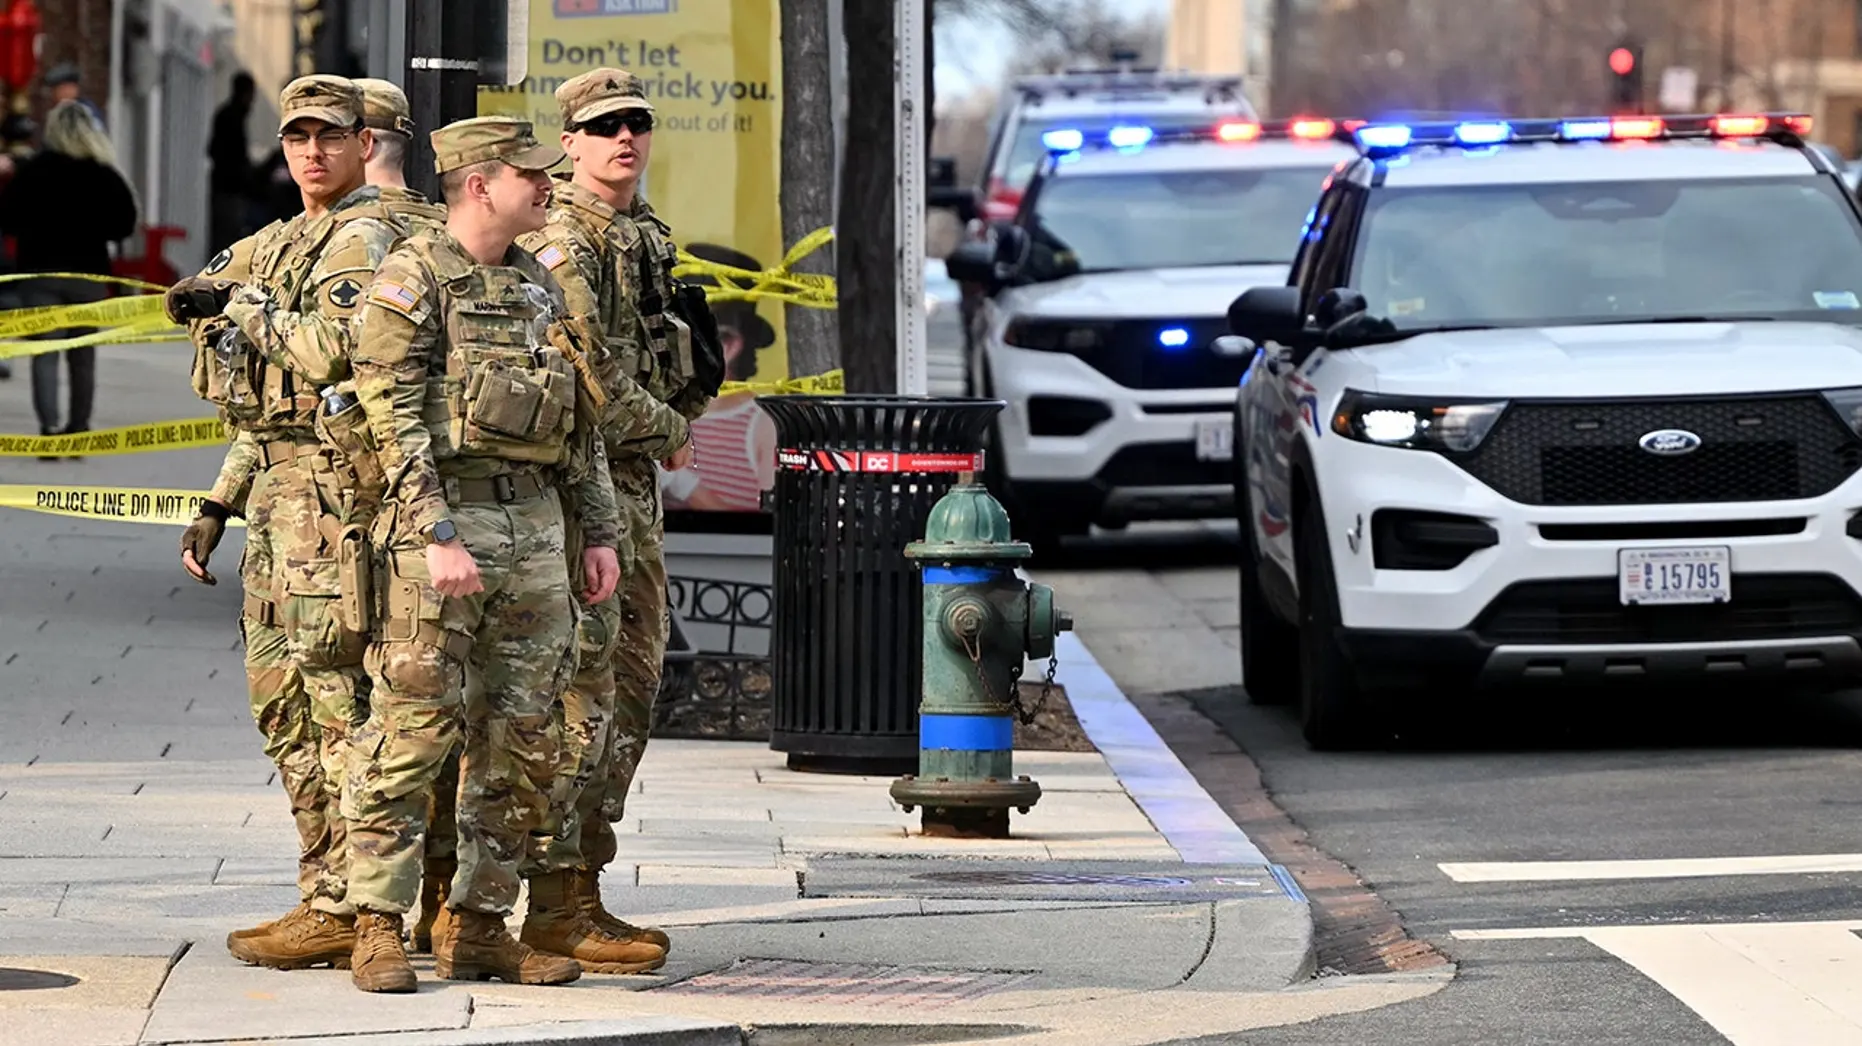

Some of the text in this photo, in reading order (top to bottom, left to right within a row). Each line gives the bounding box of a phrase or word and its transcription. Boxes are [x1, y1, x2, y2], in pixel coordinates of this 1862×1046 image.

[543, 39, 681, 67] Don't let
[643, 72, 775, 107] rick you.
[667, 114, 701, 131] out
[707, 112, 731, 131] of
[734, 113, 753, 132] it!
[125, 428, 154, 448] POLICE
[179, 424, 193, 442] DO
[194, 422, 213, 440] NOT
[779, 453, 807, 465] TRASH
[867, 456, 889, 471] DC
[36, 490, 89, 513] POLICE
[94, 492, 126, 516] LINE
[131, 493, 150, 517] DO
[156, 495, 184, 519] NOT
[1661, 562, 1720, 590] 15795
